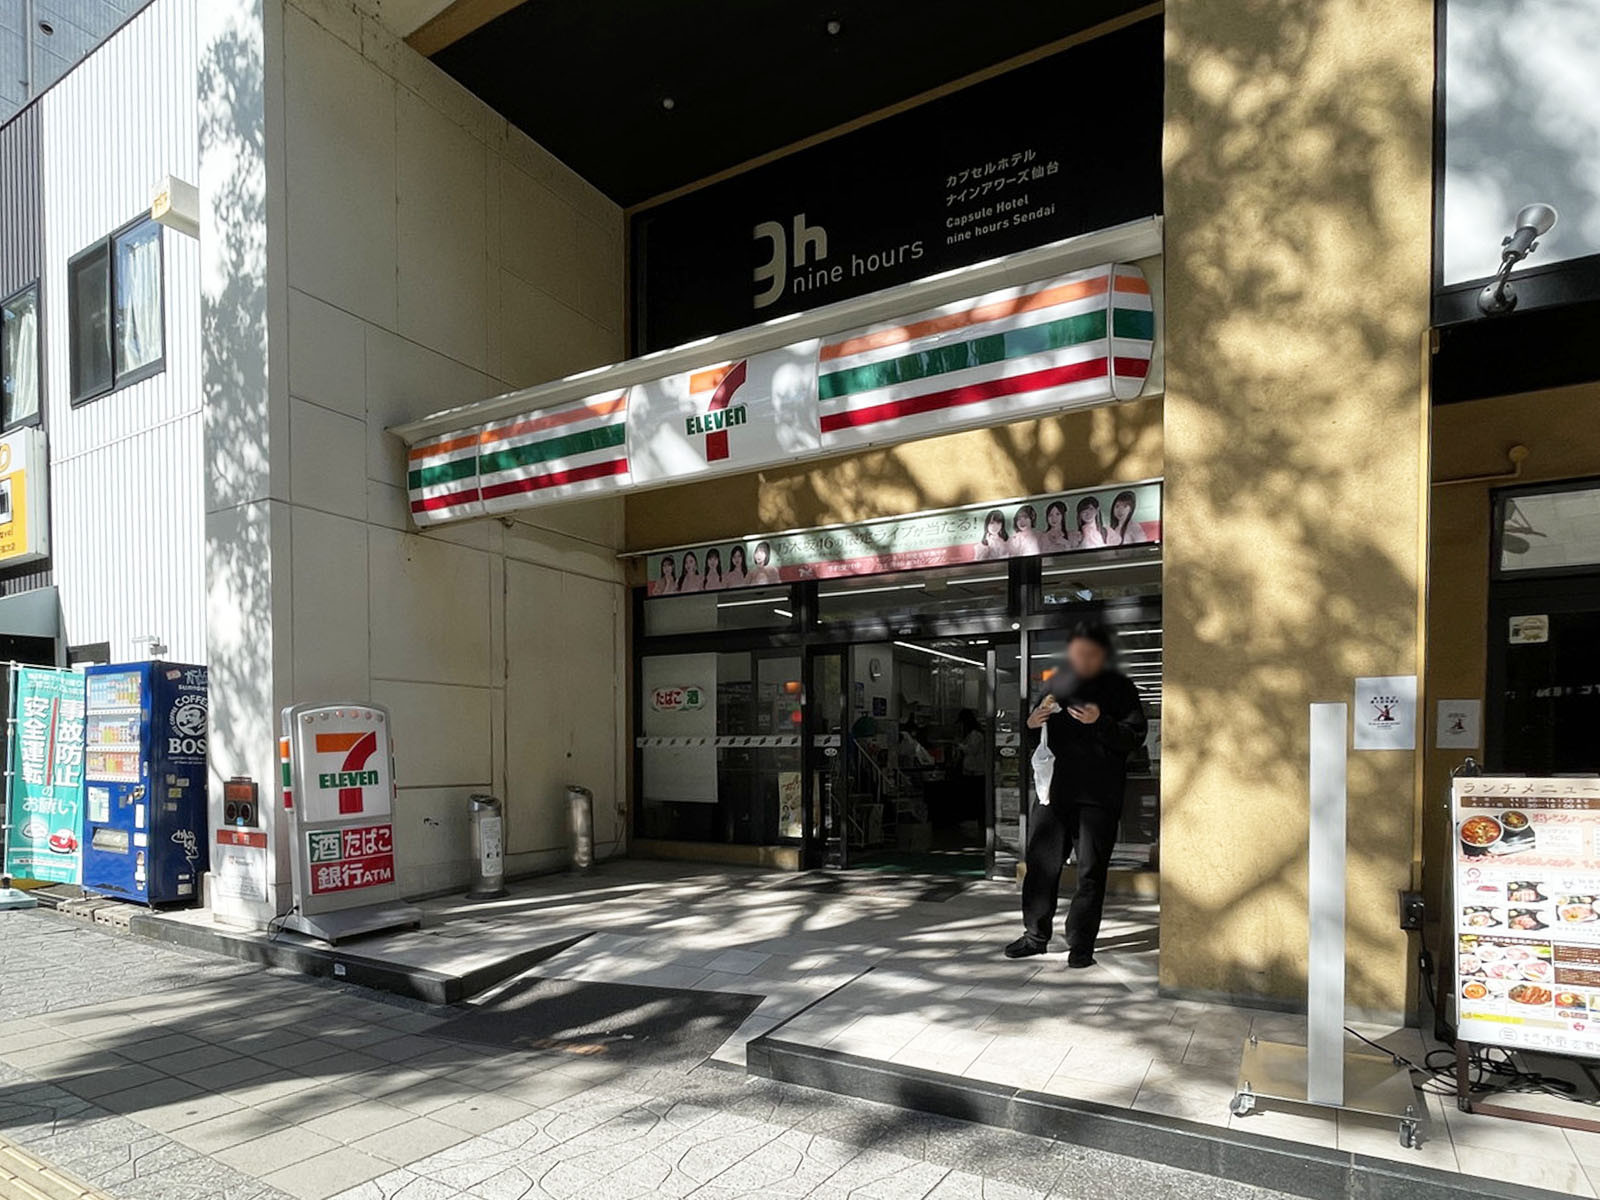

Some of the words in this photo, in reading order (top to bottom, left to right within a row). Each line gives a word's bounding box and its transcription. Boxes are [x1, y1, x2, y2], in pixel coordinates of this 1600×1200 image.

[945, 148, 1037, 188] カプセルホテル
[945, 161, 1060, 207] ナインアワーズ仙台
[946, 205, 993, 229] Capsule
[996, 194, 1029, 214] Hotel
[946, 228, 972, 245] nine
[975, 217, 1010, 237] hours
[1013, 203, 1056, 226] Sendai
[793, 266, 843, 294] nine
[851, 239, 925, 278] hours
[689, 359, 747, 462] 7
[655, 690, 683, 706] たばこ
[22, 696, 50, 785] 安全運転
[55, 698, 85, 787] 事故防止
[42, 786, 54, 797] の
[315, 731, 378, 815] 7
[1463, 782, 1600, 794] ランチメニュー
[22, 796, 78, 816] お願い
[312, 834, 340, 863] 酒
[344, 828, 392, 857] たばこ
